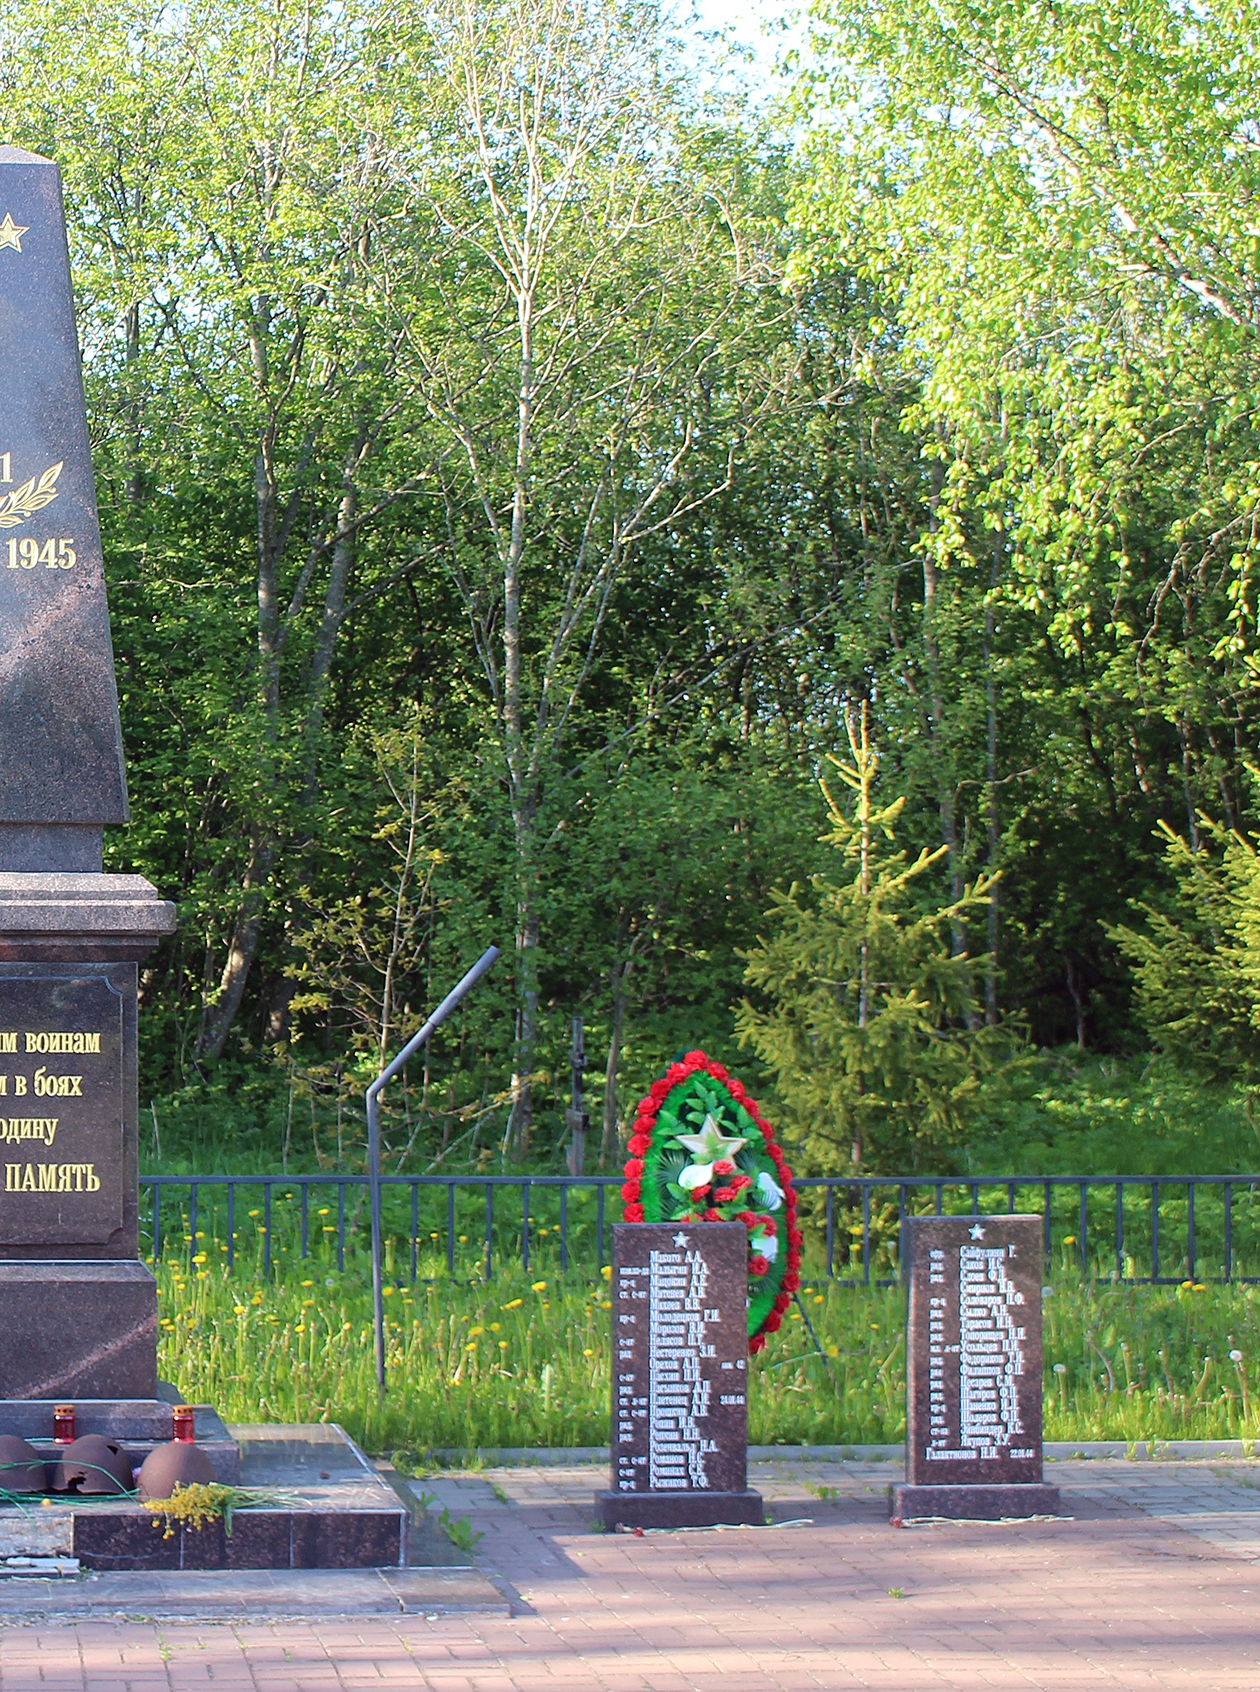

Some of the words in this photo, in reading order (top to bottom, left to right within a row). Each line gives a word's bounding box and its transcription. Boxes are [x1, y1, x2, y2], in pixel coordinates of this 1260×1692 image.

[6, 537, 77, 570] 1945
[25, 1032, 101, 1054] воинам
[14, 1075, 28, 1097] в
[33, 1066, 83, 1097] боях
[4, 1162, 102, 1193] ПАМЯТЬ
